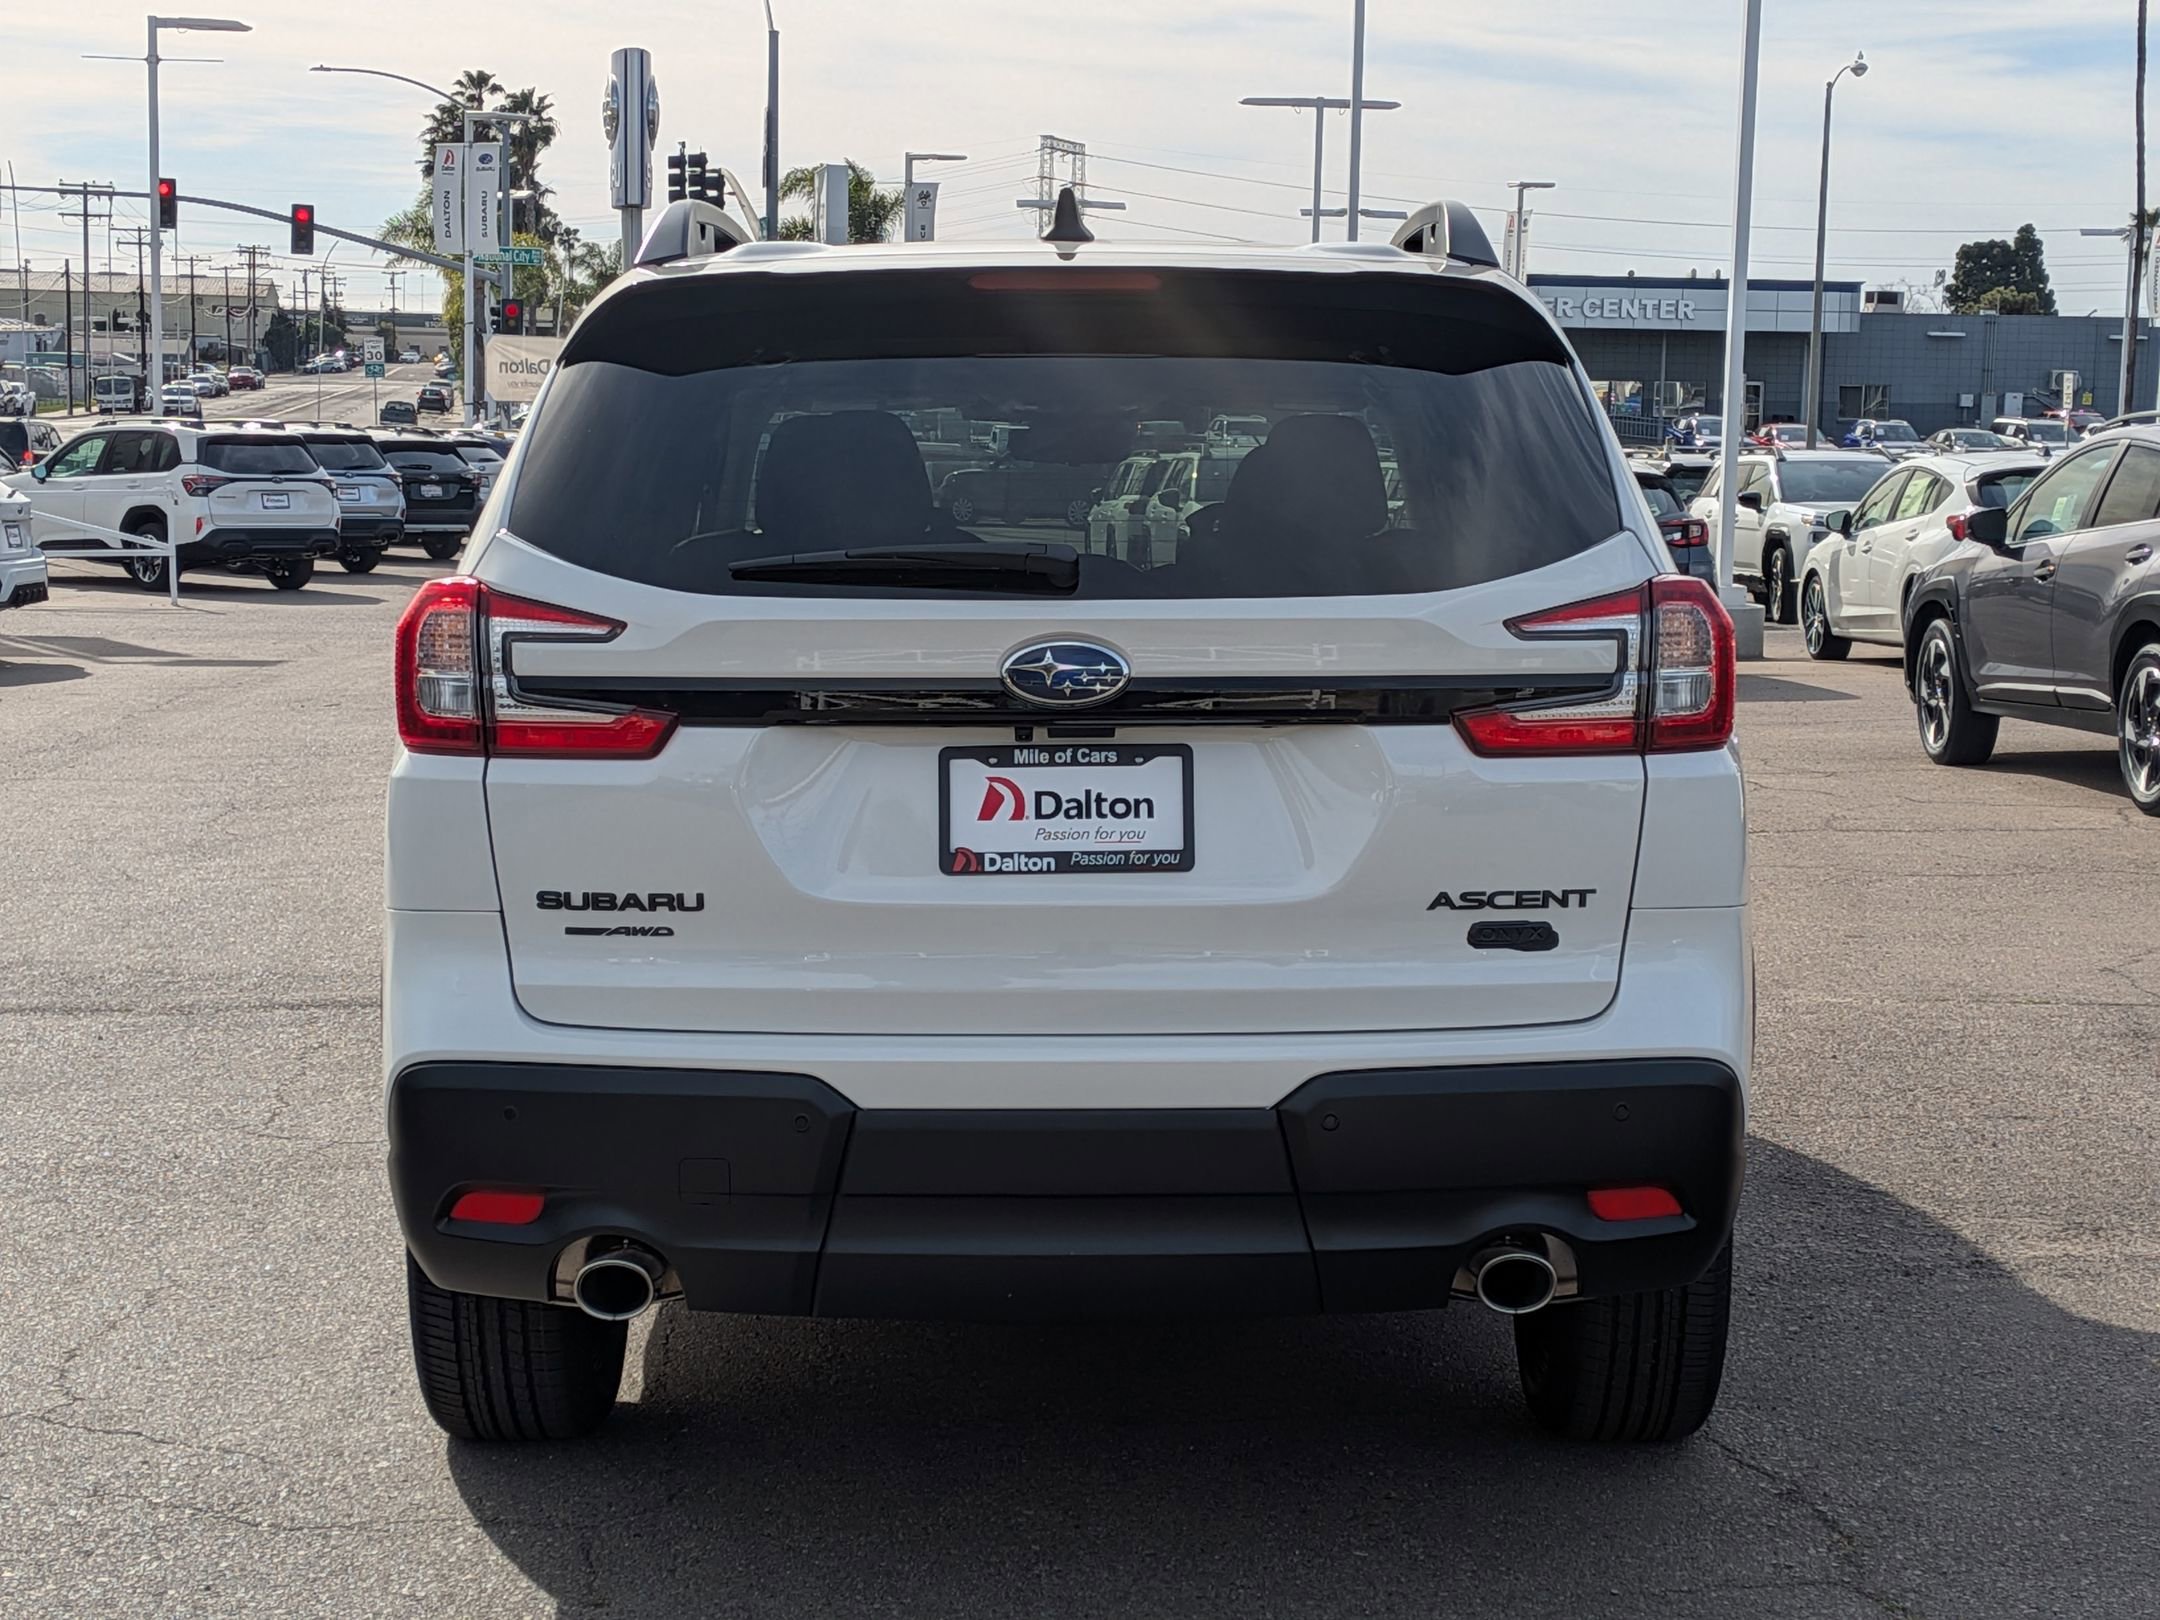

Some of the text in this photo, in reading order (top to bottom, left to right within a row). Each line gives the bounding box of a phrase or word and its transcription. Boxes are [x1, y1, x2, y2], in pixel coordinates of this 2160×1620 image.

[443, 190, 452, 239] DALTON
[513, 250, 530, 264] City
[1582, 298, 1696, 320] CENTER
[366, 351, 383, 361] 30
[1014, 748, 1118, 764] Mile of Cars
[1034, 789, 1155, 820] Dalton
[1035, 826, 1147, 843] Passion for you
[983, 853, 1056, 872] Dalton
[1070, 851, 1181, 867] Passion for you
[536, 890, 705, 912] SUBARU
[1426, 889, 1597, 911] ASCENT
[605, 926, 675, 937] AWD
